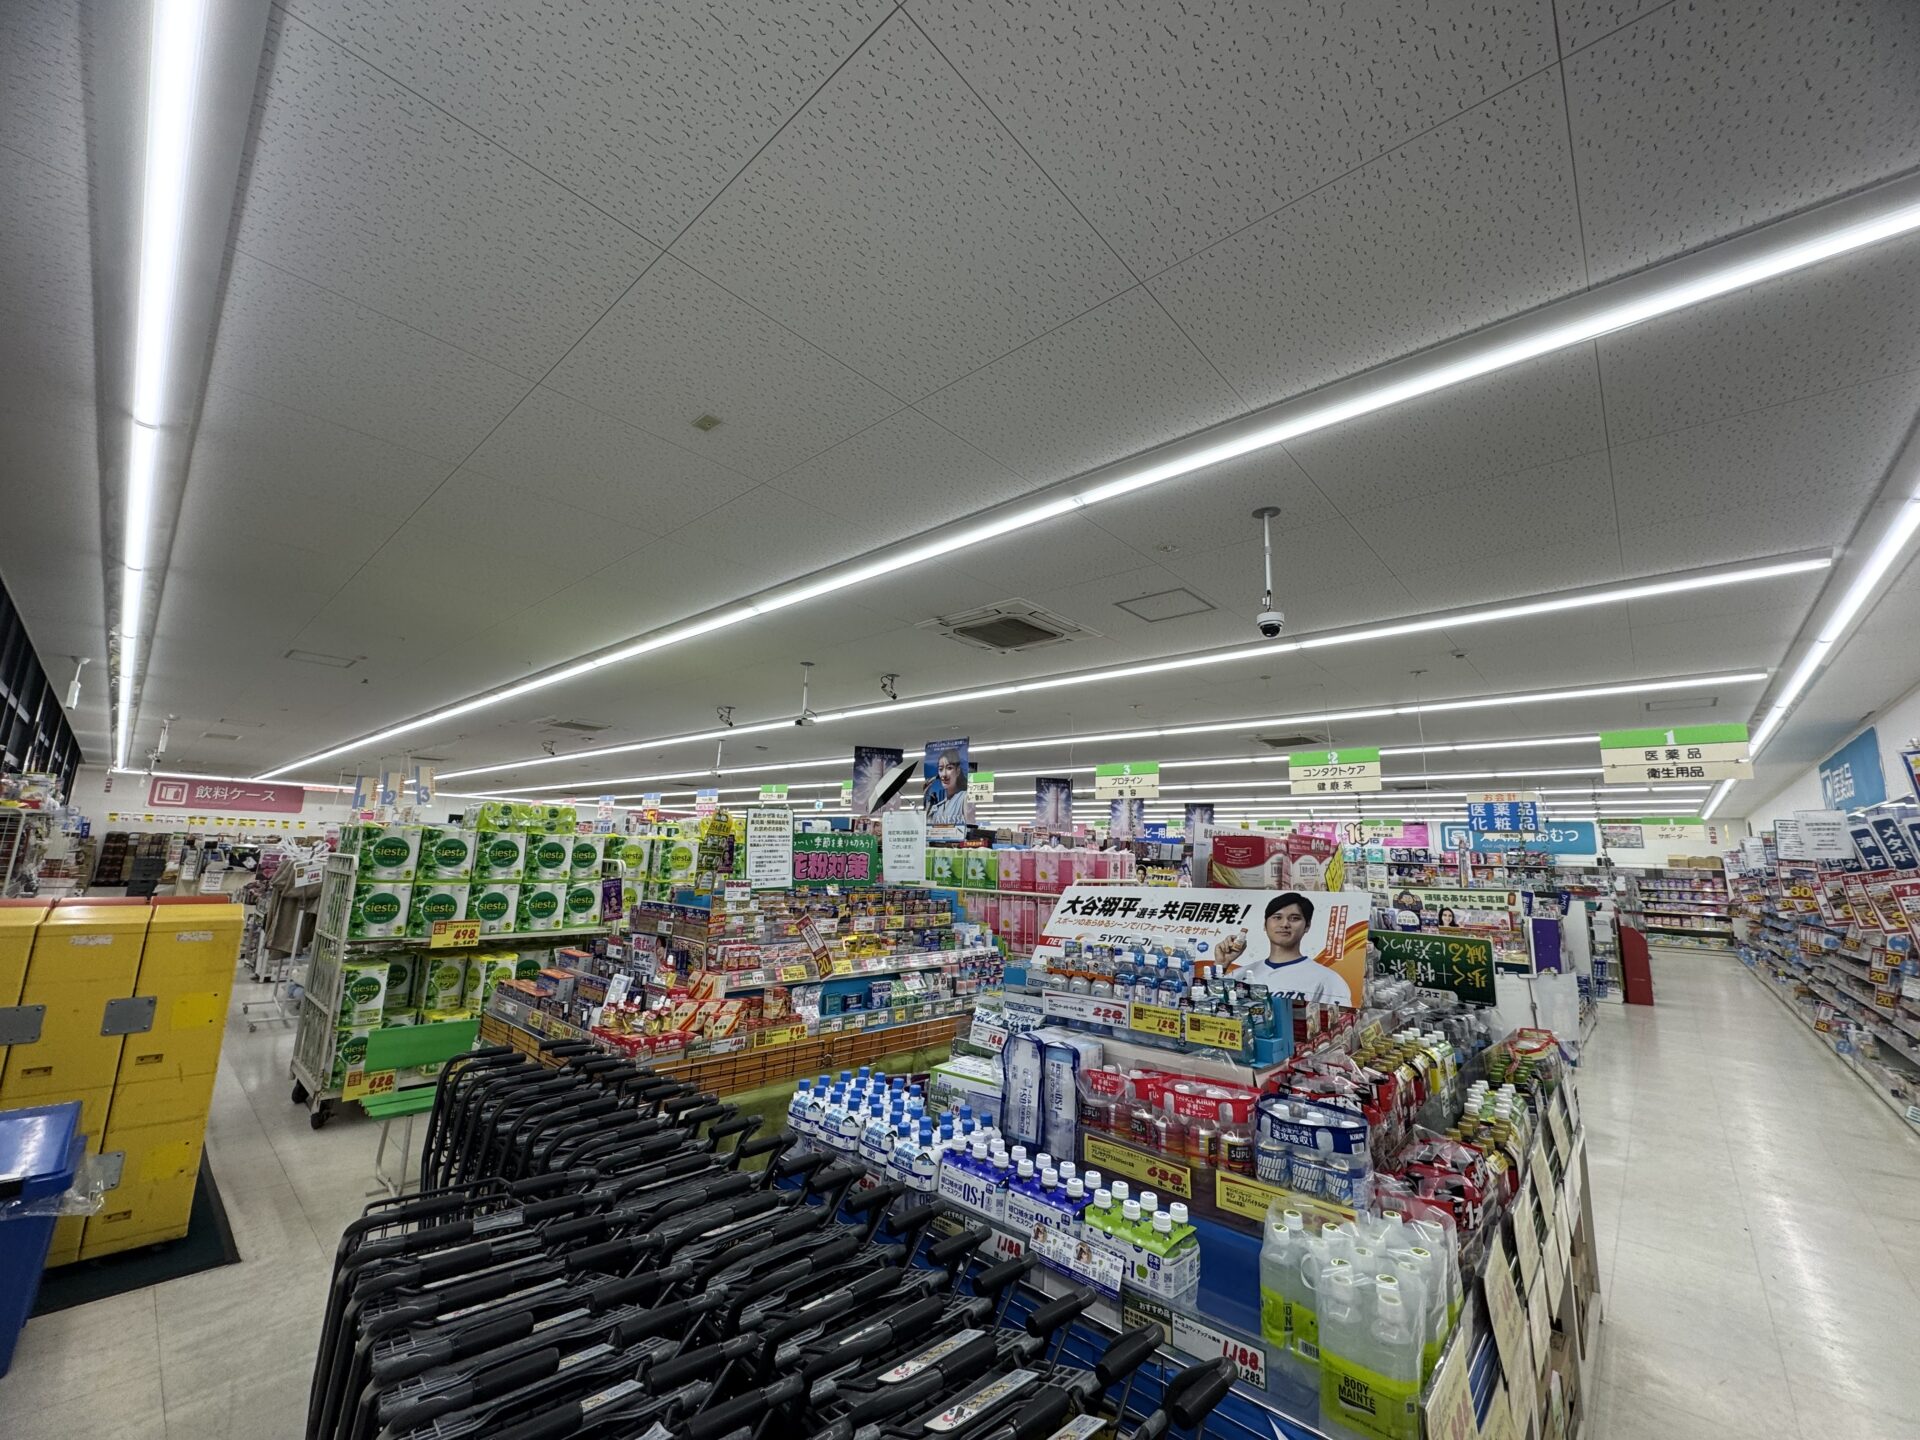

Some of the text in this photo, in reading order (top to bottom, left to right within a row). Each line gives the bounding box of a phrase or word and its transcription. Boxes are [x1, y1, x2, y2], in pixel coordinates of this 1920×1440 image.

[1664, 730, 1676, 745] 1
[1328, 752, 1339, 764] 2
[1645, 748, 1702, 761] 医薬品
[1123, 764, 1131, 775] 3
[1303, 766, 1365, 777] コンタクトケア
[1647, 766, 1704, 779] 衛生用品
[1111, 777, 1143, 785] プロテイン
[1317, 781, 1353, 791] 健康茶
[195, 785, 276, 802] 飲料ケース
[1118, 789, 1137, 797] 美容
[1484, 794, 1516, 802] お会計
[1470, 802, 1534, 817] 医薬品
[1471, 817, 1536, 831] 化粧品
[1882, 826, 1913, 862] メタボ
[374, 847, 408, 856] siesta
[437, 848, 466, 857] siesta
[489, 848, 517, 858] siesta
[538, 851, 565, 859] siesta
[572, 851, 596, 859] siesta
[479, 902, 507, 911] siesta
[529, 900, 556, 909] siesta
[569, 896, 594, 905] siesta
[364, 902, 398, 913] siesta
[425, 903, 455, 913] siesta
[1055, 917, 1221, 936] スポーツのあらゆるシーンでパフォーマンスをサポート
[352, 984, 379, 993] siesta
[1092, 1006, 1123, 1020] 228
[1156, 1019, 1175, 1030] 128
[1218, 1030, 1237, 1042] 118
[1196, 1098, 1216, 1107] KIRIN
[1257, 1154, 1287, 1169] amino
[1257, 1165, 1280, 1181] VITAL
[1292, 1163, 1324, 1180] amino
[1292, 1174, 1317, 1192] VITAL
[962, 1182, 985, 1209] OS-1
[1008, 1213, 1034, 1229] オーエスワン
[1139, 1303, 1171, 1319] おすすめ品
[1343, 1376, 1370, 1395] BODY
[1338, 1384, 1376, 1410] MAINTÉ
